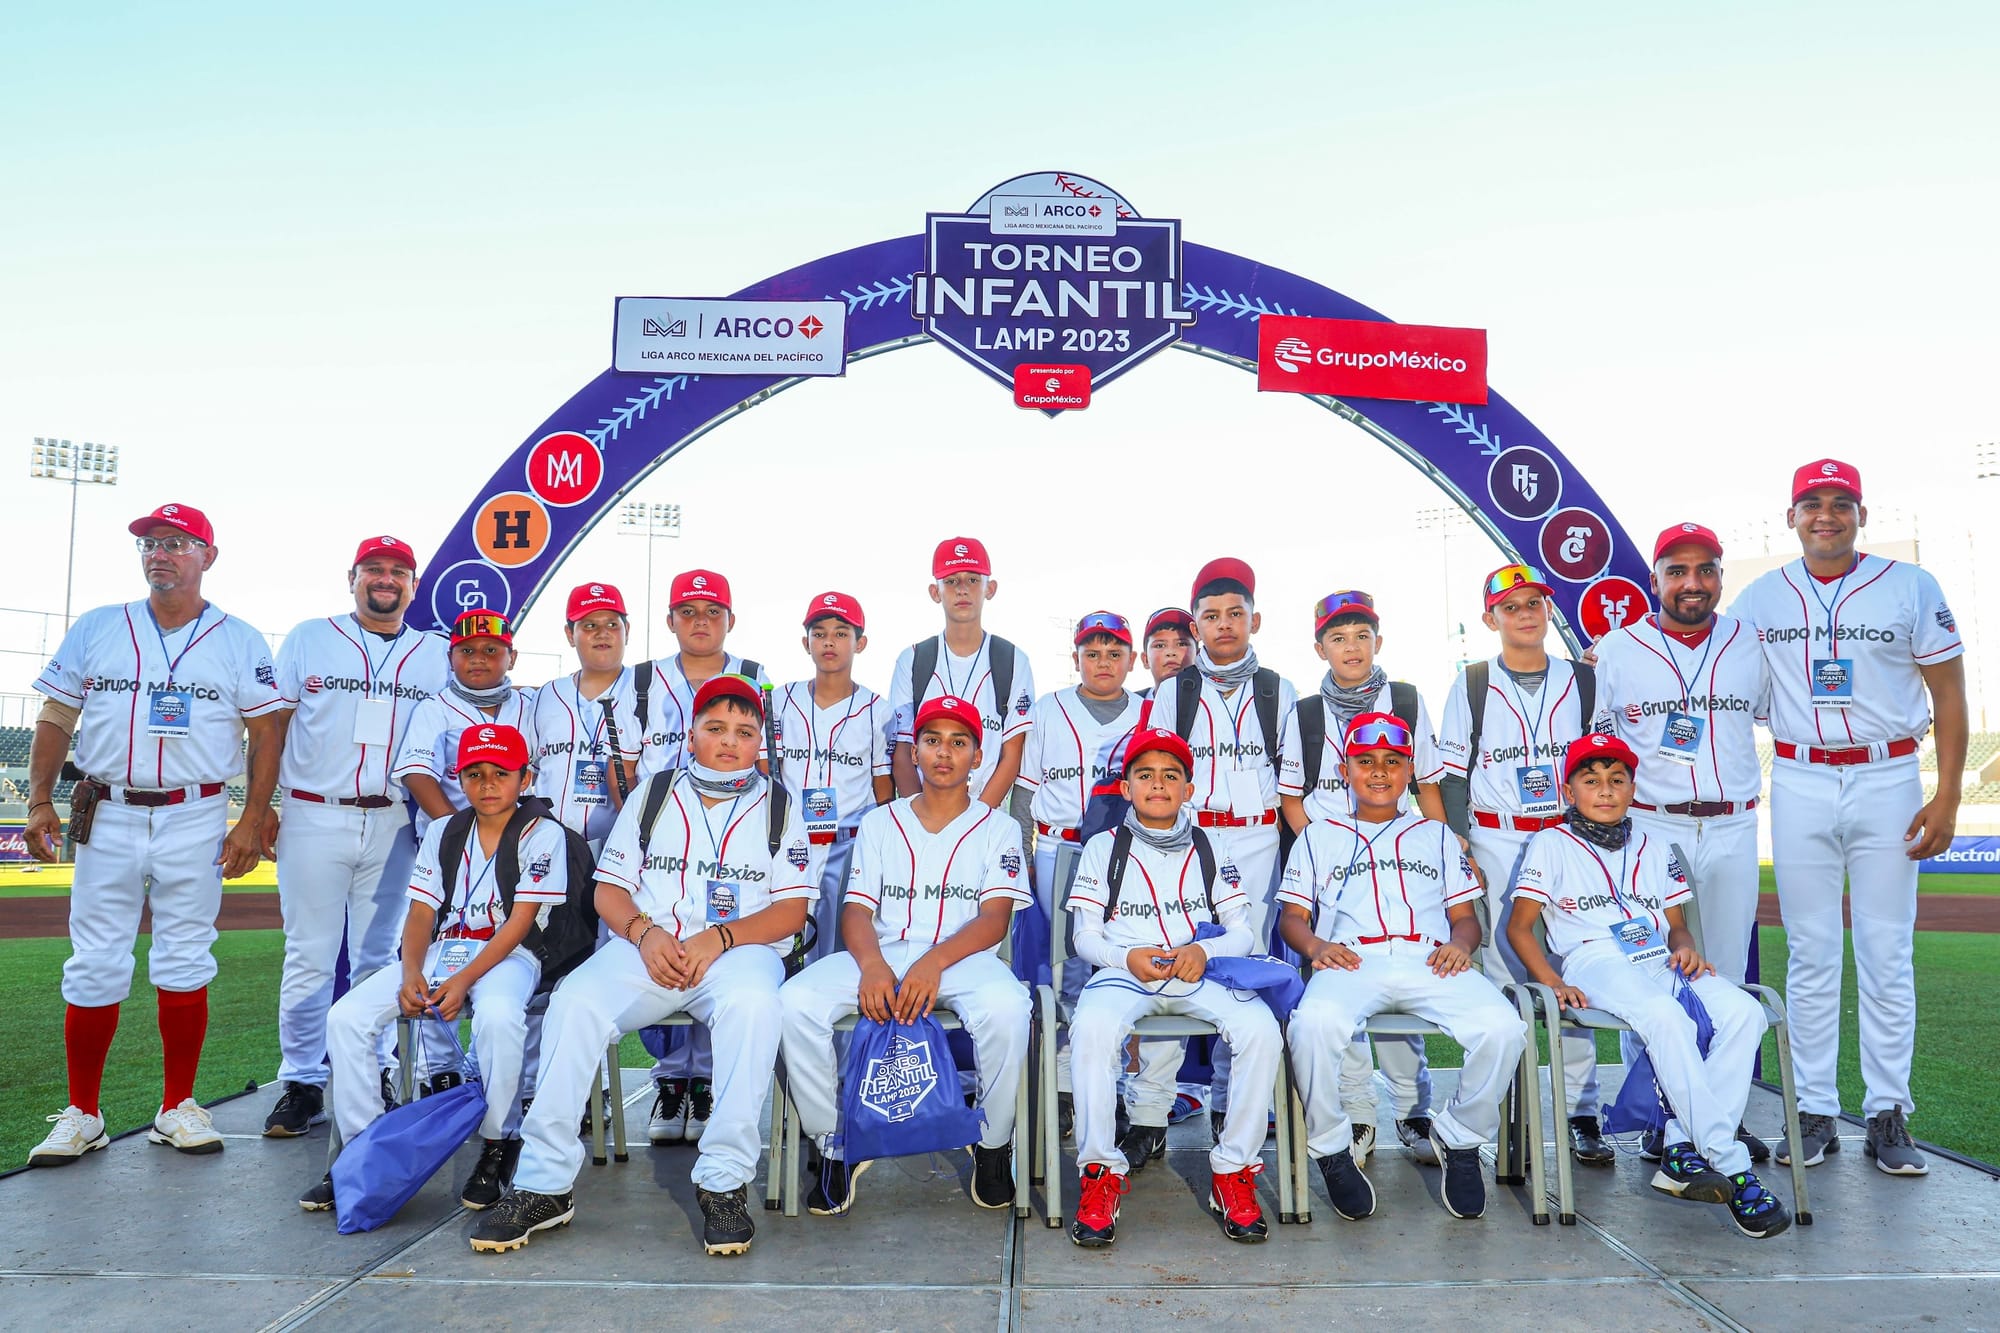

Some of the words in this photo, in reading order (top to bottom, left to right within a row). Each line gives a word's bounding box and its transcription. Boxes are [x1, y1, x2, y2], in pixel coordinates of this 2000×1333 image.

[1043, 205, 1086, 217] ARCO
[964, 243, 1142, 273] TORNEO
[916, 277, 1192, 319] INFANTIL
[713, 317, 794, 339] ARCO
[975, 327, 1055, 351] LAMP
[1062, 329, 1130, 352] 2023
[641, 351, 665, 360] LIGA
[666, 351, 696, 361] ARCO
[698, 353, 751, 362] MEXICANA
[753, 354, 774, 362] DEL
[776, 352, 823, 362] PACÍFICO
[1316, 347, 1467, 374] GrupoMéxico
[1023, 395, 1082, 405] GrupoMéxico
[493, 511, 530, 549] H
[1766, 627, 1811, 644] Grupo
[1815, 624, 1896, 643] México
[323, 676, 372, 694] Grupo
[1691, 694, 1750, 713] México
[1493, 745, 1530, 763] Grupo
[1049, 767, 1085, 782] Grupo
[573, 796, 607, 805] JUGADOR
[1523, 804, 1558, 814] JUGADOR
[807, 823, 836, 831] JUGADOR
[696, 860, 766, 883] México
[1333, 861, 1378, 882] Grupo
[1379, 858, 1439, 881] México
[882, 884, 918, 901] rupo
[1120, 901, 1161, 919] Grupo
[1166, 892, 1207, 915] Méxi
[1631, 948, 1668, 963] JUGADOR
[874, 1092, 897, 1104] LAMP
[898, 1084, 921, 1098] 2023
